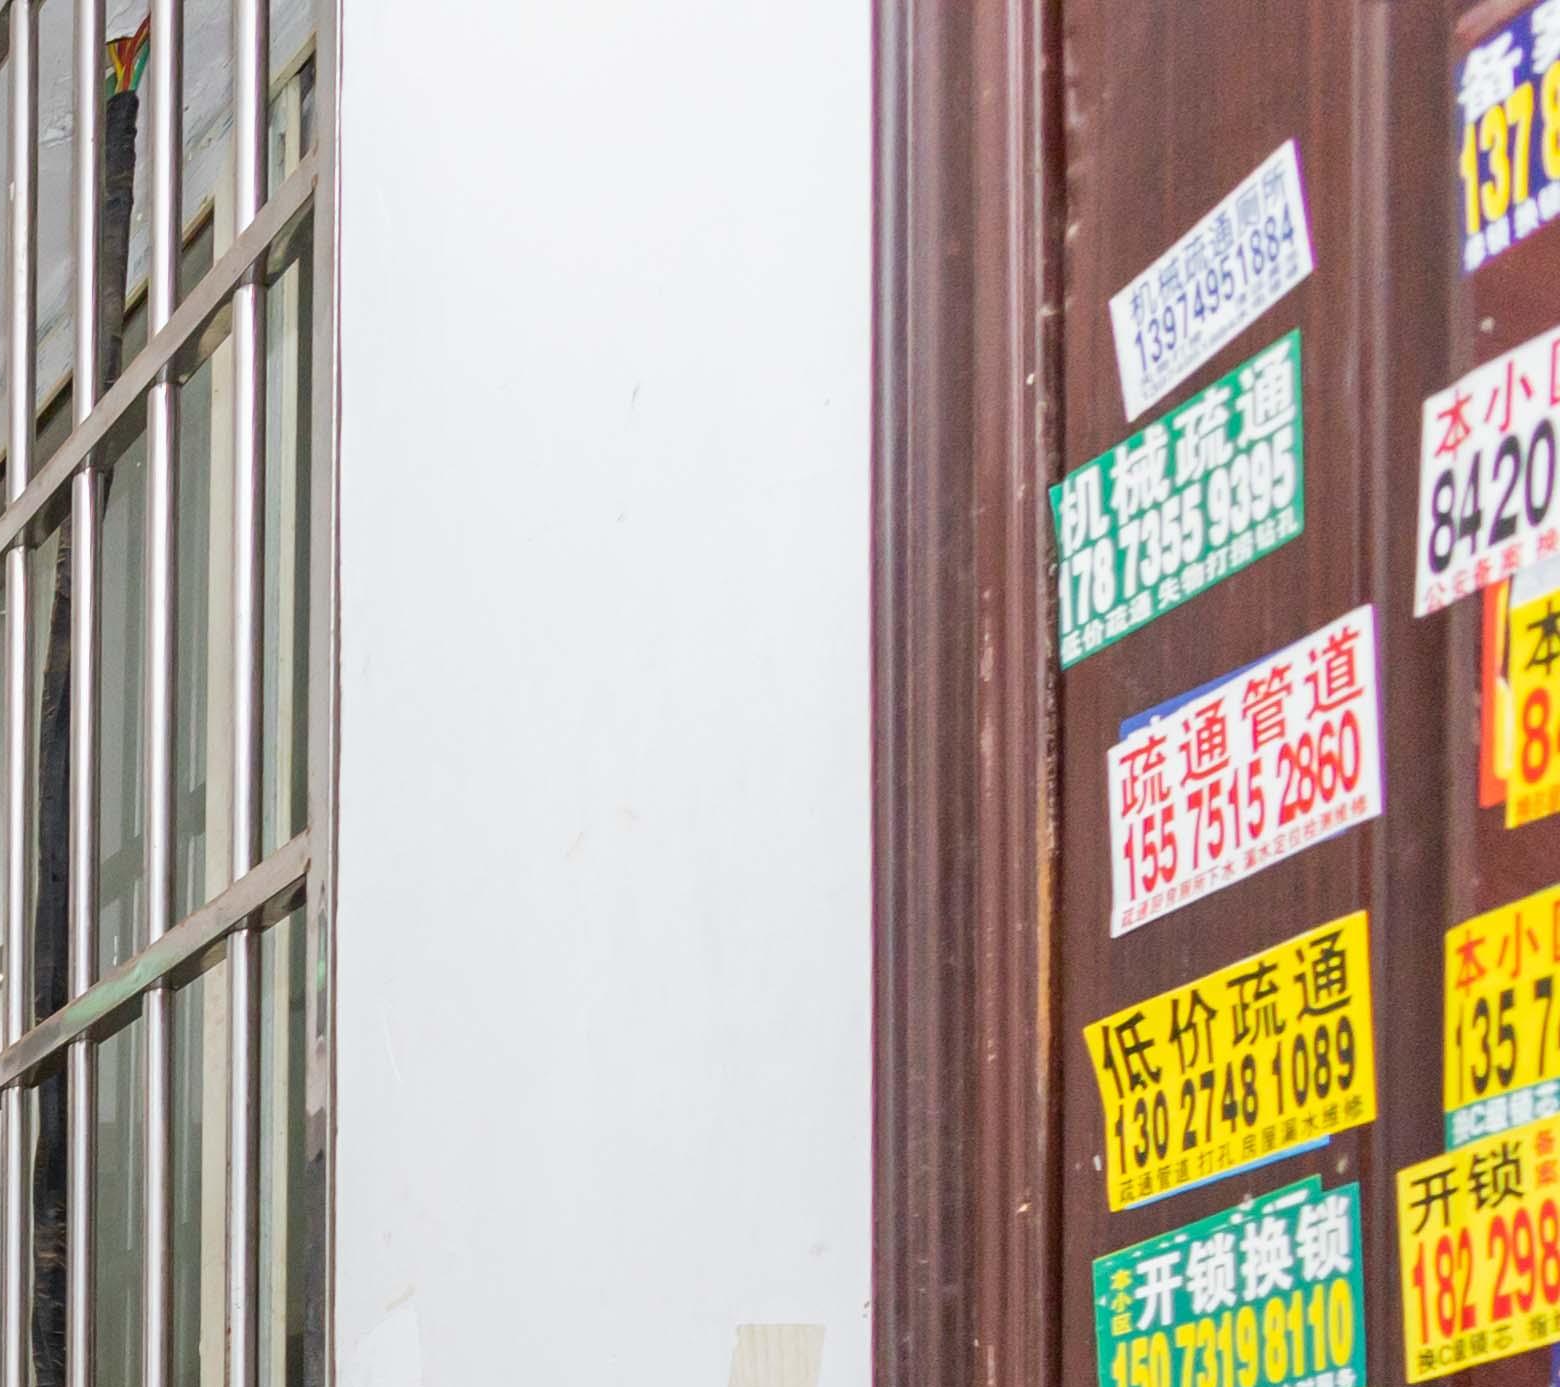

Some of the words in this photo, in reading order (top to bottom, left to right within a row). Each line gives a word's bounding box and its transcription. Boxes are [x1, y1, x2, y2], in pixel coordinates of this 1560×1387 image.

[1058, 338, 1299, 560] 机械疏通
[1430, 417, 1556, 573] 8420
[1058, 543, 1110, 634] 178
[1120, 481, 1206, 595] 7355
[1206, 439, 1299, 555] 9395
[1119, 626, 1366, 819] 疏通管道
[1123, 816, 1180, 902] 155
[1187, 759, 1268, 871] 7515
[1275, 708, 1363, 827] 2860
[1102, 927, 1354, 1099] 低价疏通
[1454, 986, 1518, 1100] 135
[1114, 1089, 1170, 1175] 130
[1179, 1053, 1259, 1152] 2748
[1271, 1014, 1356, 1117] 1089
[1134, 1194, 1353, 1332] 开锁换锁
[1409, 1139, 1525, 1236] 开锁
[1263, 1278, 1355, 1385] 8110
[1410, 1227, 1476, 1345] 182
